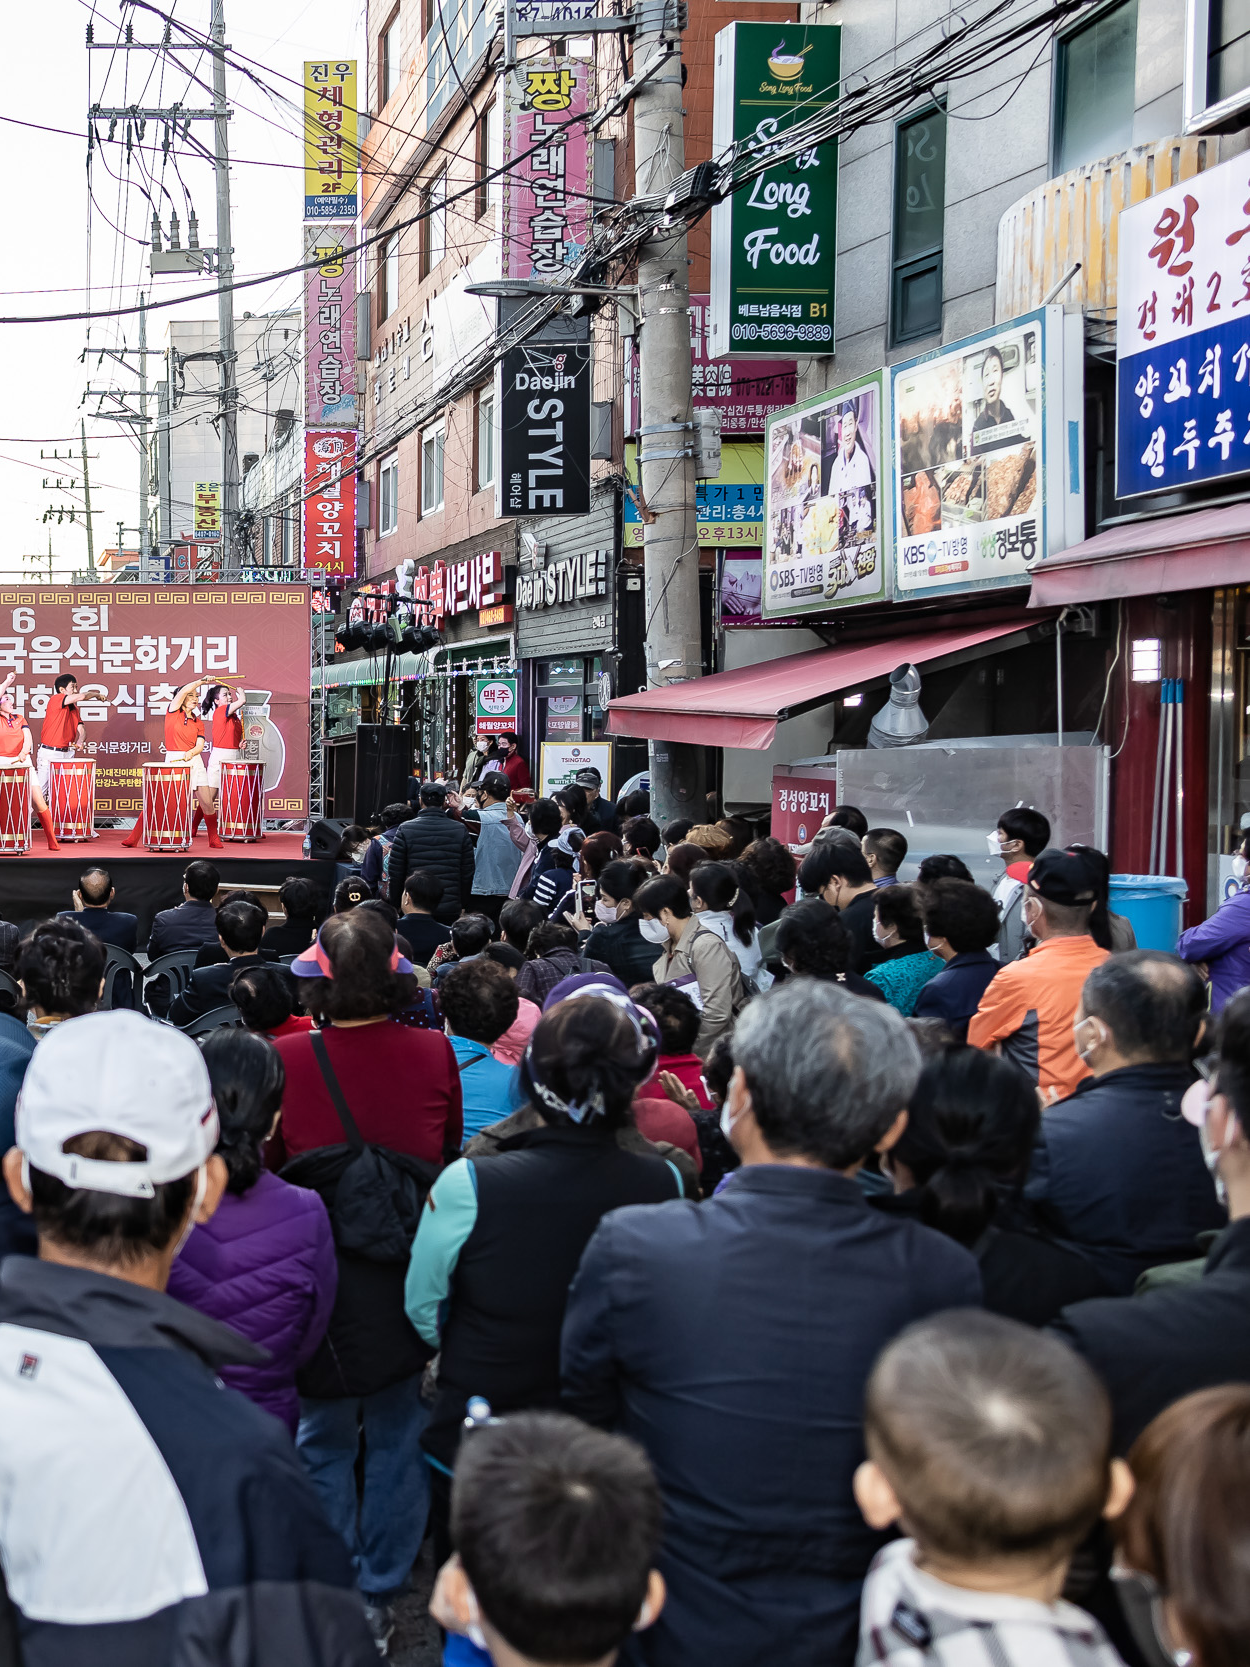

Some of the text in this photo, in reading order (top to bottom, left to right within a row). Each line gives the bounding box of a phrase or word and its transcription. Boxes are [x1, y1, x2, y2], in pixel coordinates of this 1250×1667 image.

[310, 63, 352, 82] 진우
[525, 69, 576, 111] 짱
[759, 81, 813, 95] Song Long Food
[315, 85, 345, 180] 체형관리
[321, 182, 341, 193] 2F
[530, 113, 568, 273] 노래연습장
[746, 170, 811, 219] Long
[743, 226, 821, 270] Food
[738, 303, 828, 318] 베트남음식점 B1
[318, 279, 344, 406] 노래연습장
[731, 323, 832, 341] 010-5696-9889
[515, 372, 576, 392] Daejin
[527, 398, 565, 509] STYLE
[904, 544, 926, 565] KBS
[516, 551, 596, 610] Daejin STYLE
[11, 607, 36, 634] 6
[71, 604, 109, 633] 회
[483, 689, 510, 703] 맥주
[779, 789, 830, 816] 경성양꼬치
